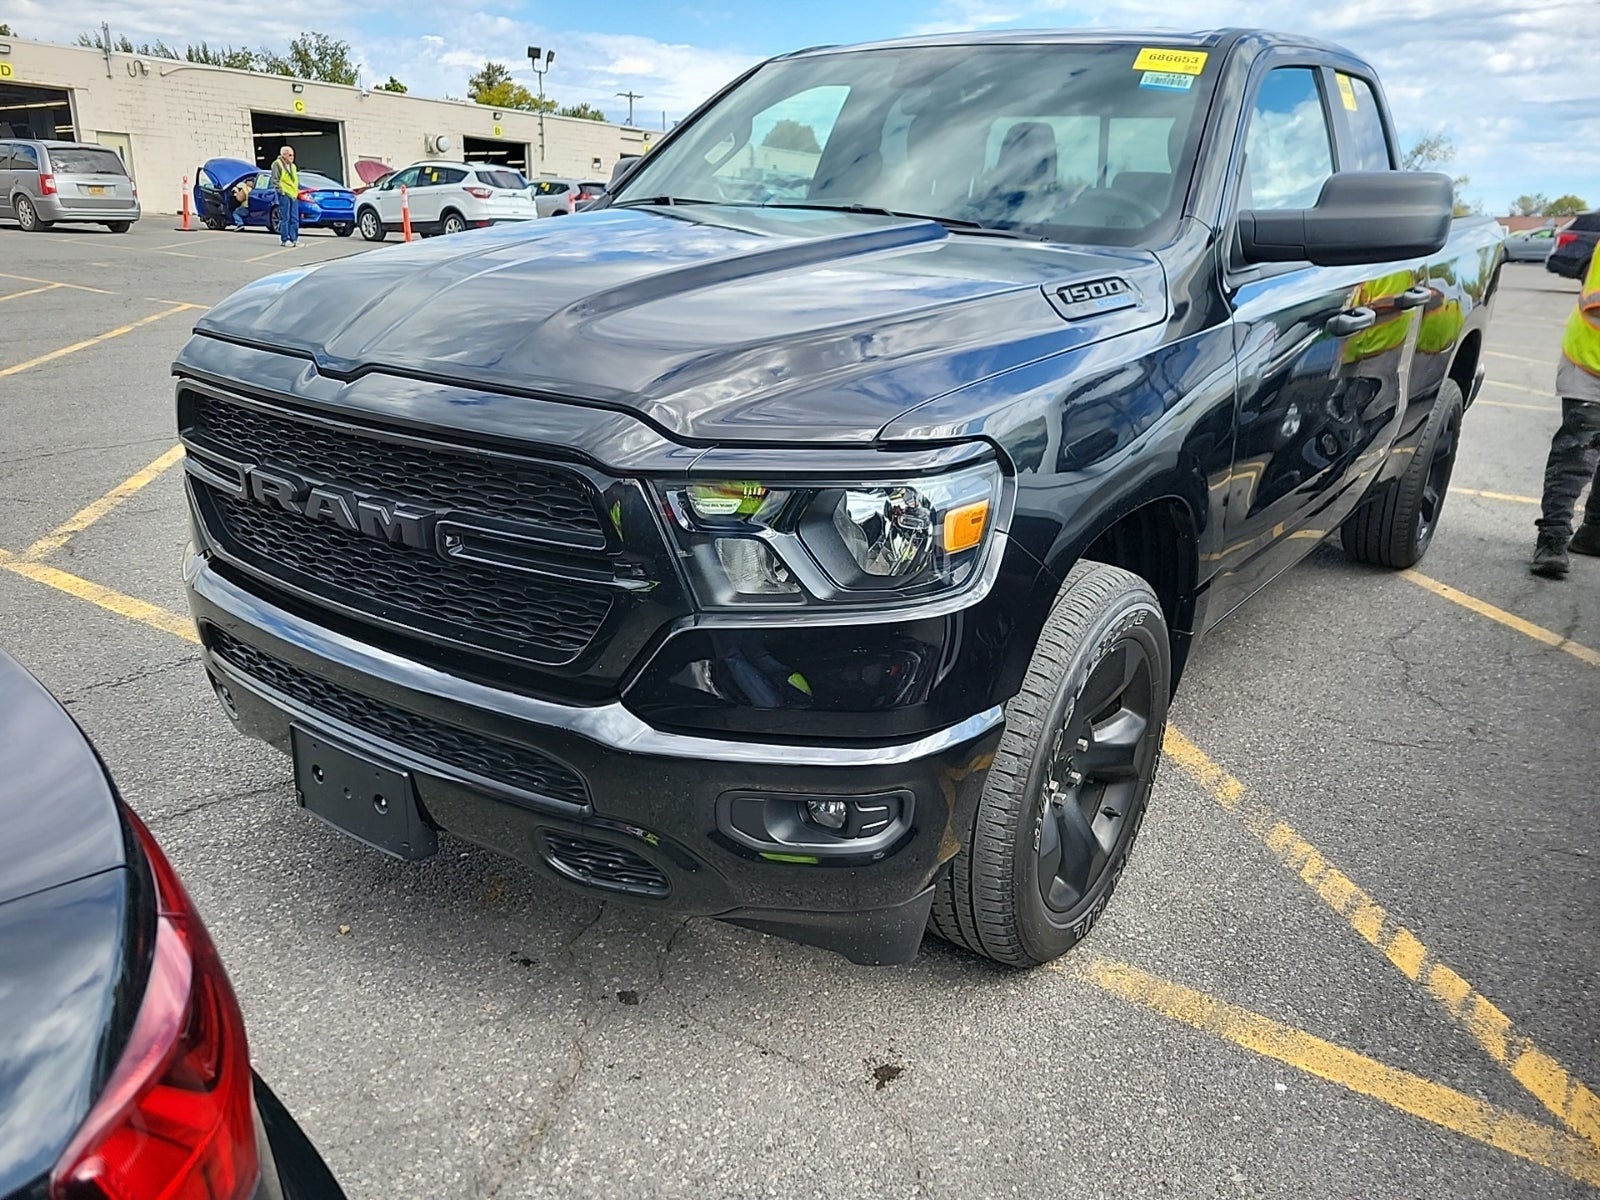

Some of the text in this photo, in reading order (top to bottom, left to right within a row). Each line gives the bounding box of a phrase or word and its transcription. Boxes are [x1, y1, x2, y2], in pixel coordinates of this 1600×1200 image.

[1148, 53, 1199, 64] 686653
[1, 65, 11, 76] D
[295, 101, 303, 111] C
[494, 127, 501, 136] B
[1059, 280, 1124, 303] 1500
[249, 468, 432, 549] RAM
